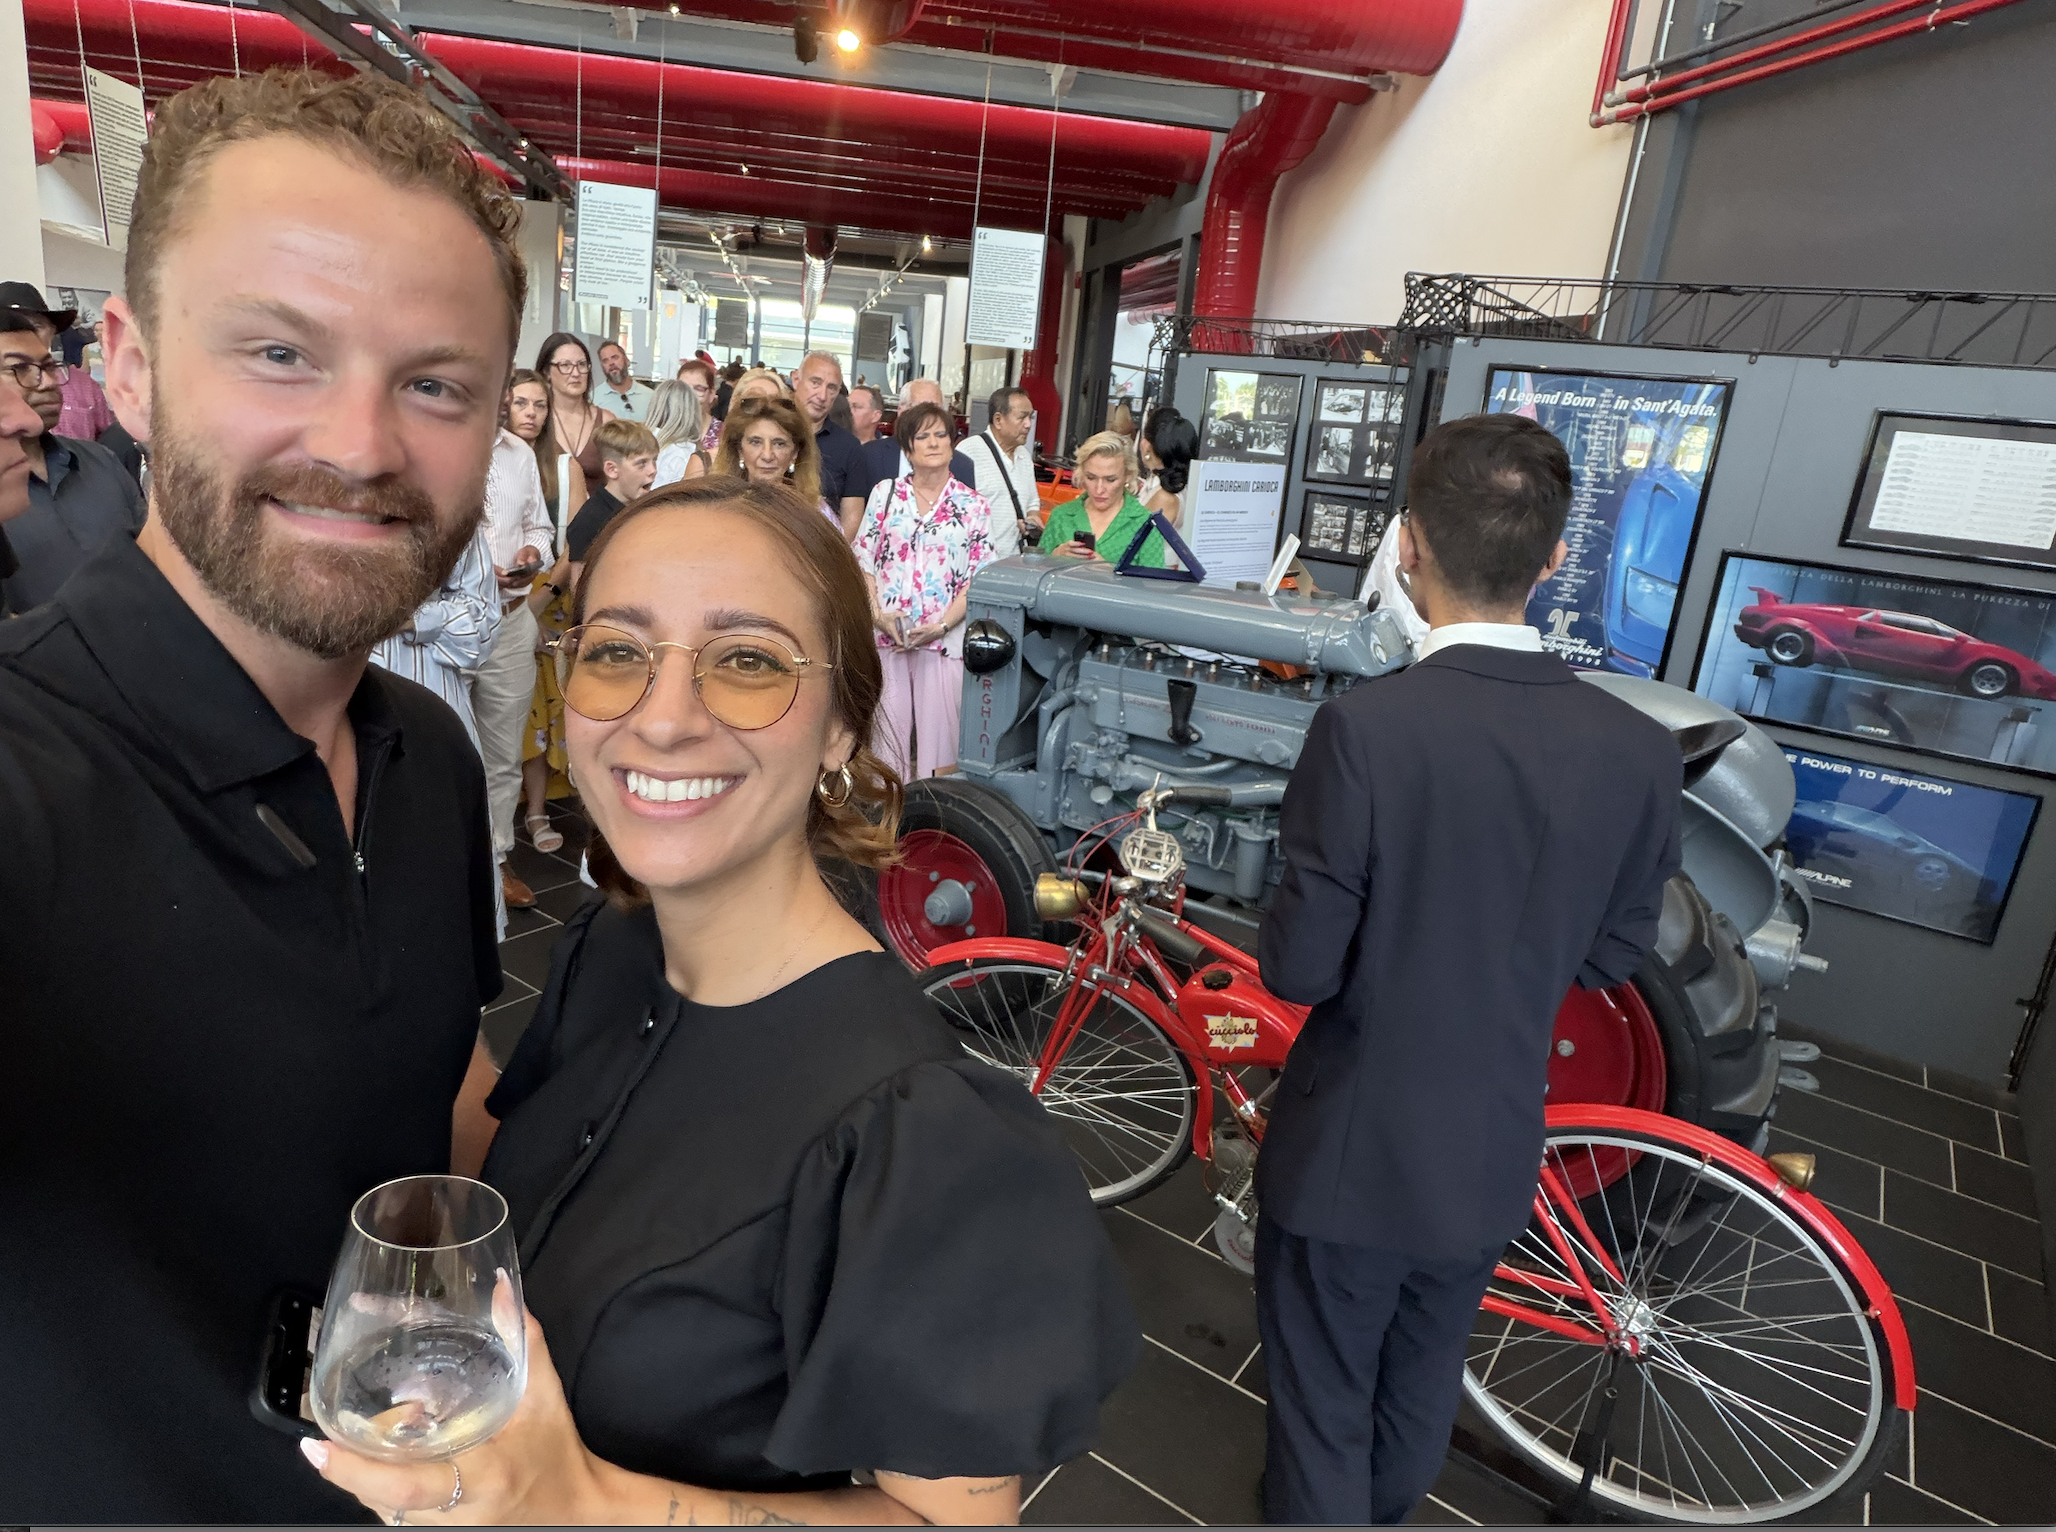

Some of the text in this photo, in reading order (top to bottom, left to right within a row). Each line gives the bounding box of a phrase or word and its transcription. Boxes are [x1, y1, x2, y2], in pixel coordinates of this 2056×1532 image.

[1495, 388, 1718, 417] A Legend Born in Sant'Agata.
[1204, 479, 1279, 493] LAMBORGHINI CARIOCA
[1819, 573, 1854, 585] DELLA
[1861, 579, 1942, 596] LAMBORGHINI
[1952, 591, 1966, 600] LA
[1973, 593, 2029, 608] PUREZZA
[2038, 602, 2051, 611] DI
[1801, 757, 1852, 775] POWER
[1858, 768, 1877, 780] TO
[1881, 774, 1953, 796] PERFORM
[1808, 870, 1853, 888] ALPINE
